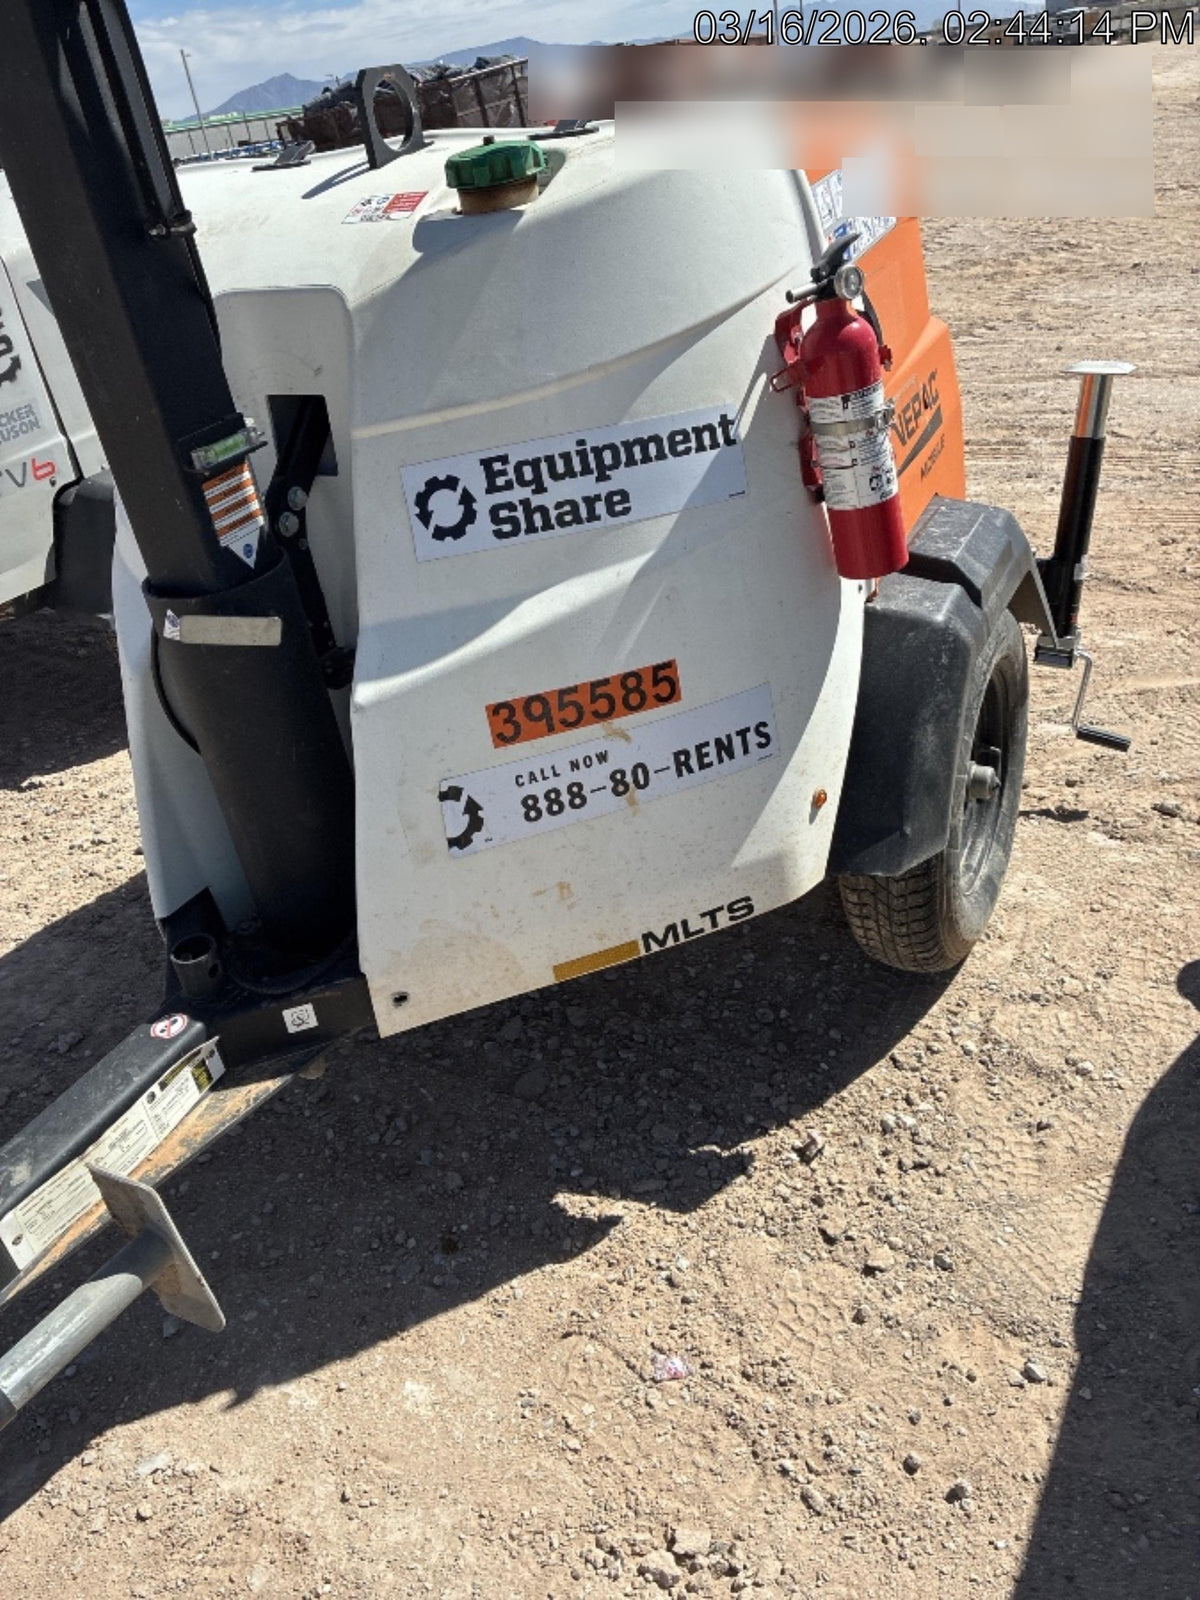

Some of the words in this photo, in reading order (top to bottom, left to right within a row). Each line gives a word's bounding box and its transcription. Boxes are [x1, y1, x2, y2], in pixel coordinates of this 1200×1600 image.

[0, 404, 36, 427] CKER
[0, 416, 41, 442] USON
[479, 414, 737, 494] Equipment
[488, 488, 632, 540] Share
[491, 662, 677, 744] 395585
[514, 764, 561, 787] CALL
[569, 750, 609, 772] NOW
[521, 721, 772, 822] 888-80-RENTS
[641, 895, 755, 953] MLTS
